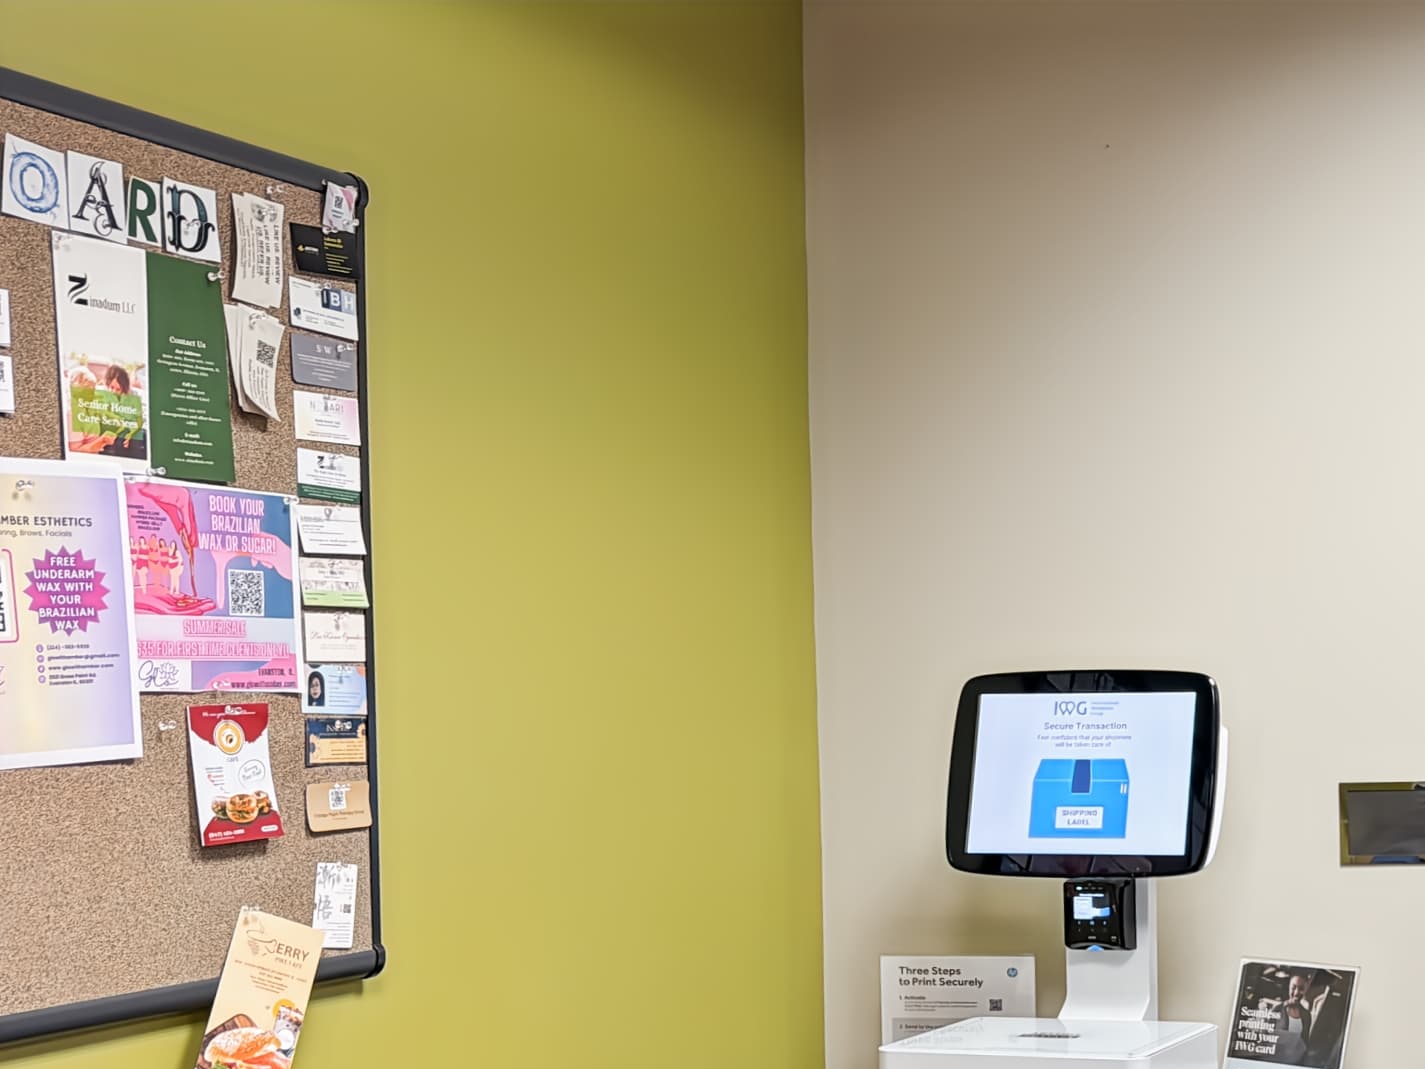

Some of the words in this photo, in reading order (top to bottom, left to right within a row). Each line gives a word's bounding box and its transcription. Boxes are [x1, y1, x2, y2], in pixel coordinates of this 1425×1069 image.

[169, 336, 196, 347] Contact
[197, 341, 206, 349] Us
[78, 398, 109, 412] Senior
[111, 402, 137, 415] Home
[77, 412, 100, 424] Care
[209, 495, 236, 513] BOOK
[240, 498, 265, 516] YOUR
[34, 516, 93, 527] ESTHETICS
[211, 515, 261, 534] BRAZILIAN
[45, 529, 73, 538] Facials
[200, 533, 223, 550] WAX
[226, 535, 240, 552] OR
[241, 536, 276, 554] SUGAR!
[50, 557, 76, 567] FREE
[34, 569, 95, 580] UNDERARM
[36, 582, 61, 592] WAX
[64, 582, 94, 592] WITH
[50, 595, 82, 605] YOUR
[38, 607, 95, 618] BRAZILIAN
[55, 620, 80, 630] WAX
[183, 620, 224, 636] SUMMER
[225, 621, 247, 636] SALE
[1054, 701, 1088, 716] IWG
[1044, 722, 1074, 730] Secure
[1076, 721, 1127, 730] Transaction
[899, 966, 930, 976] Three
[931, 966, 962, 977] Steps
[899, 977, 911, 986] to
[912, 977, 937, 986] Print
[938, 977, 984, 988] Securely
[1240, 1006, 1282, 1020] Seamless
[1238, 1018, 1275, 1033] printing
[1237, 1030, 1257, 1042] with
[1257, 1033, 1279, 1044] your
[1235, 1040, 1255, 1053] IWG
[1256, 1043, 1276, 1055] card
